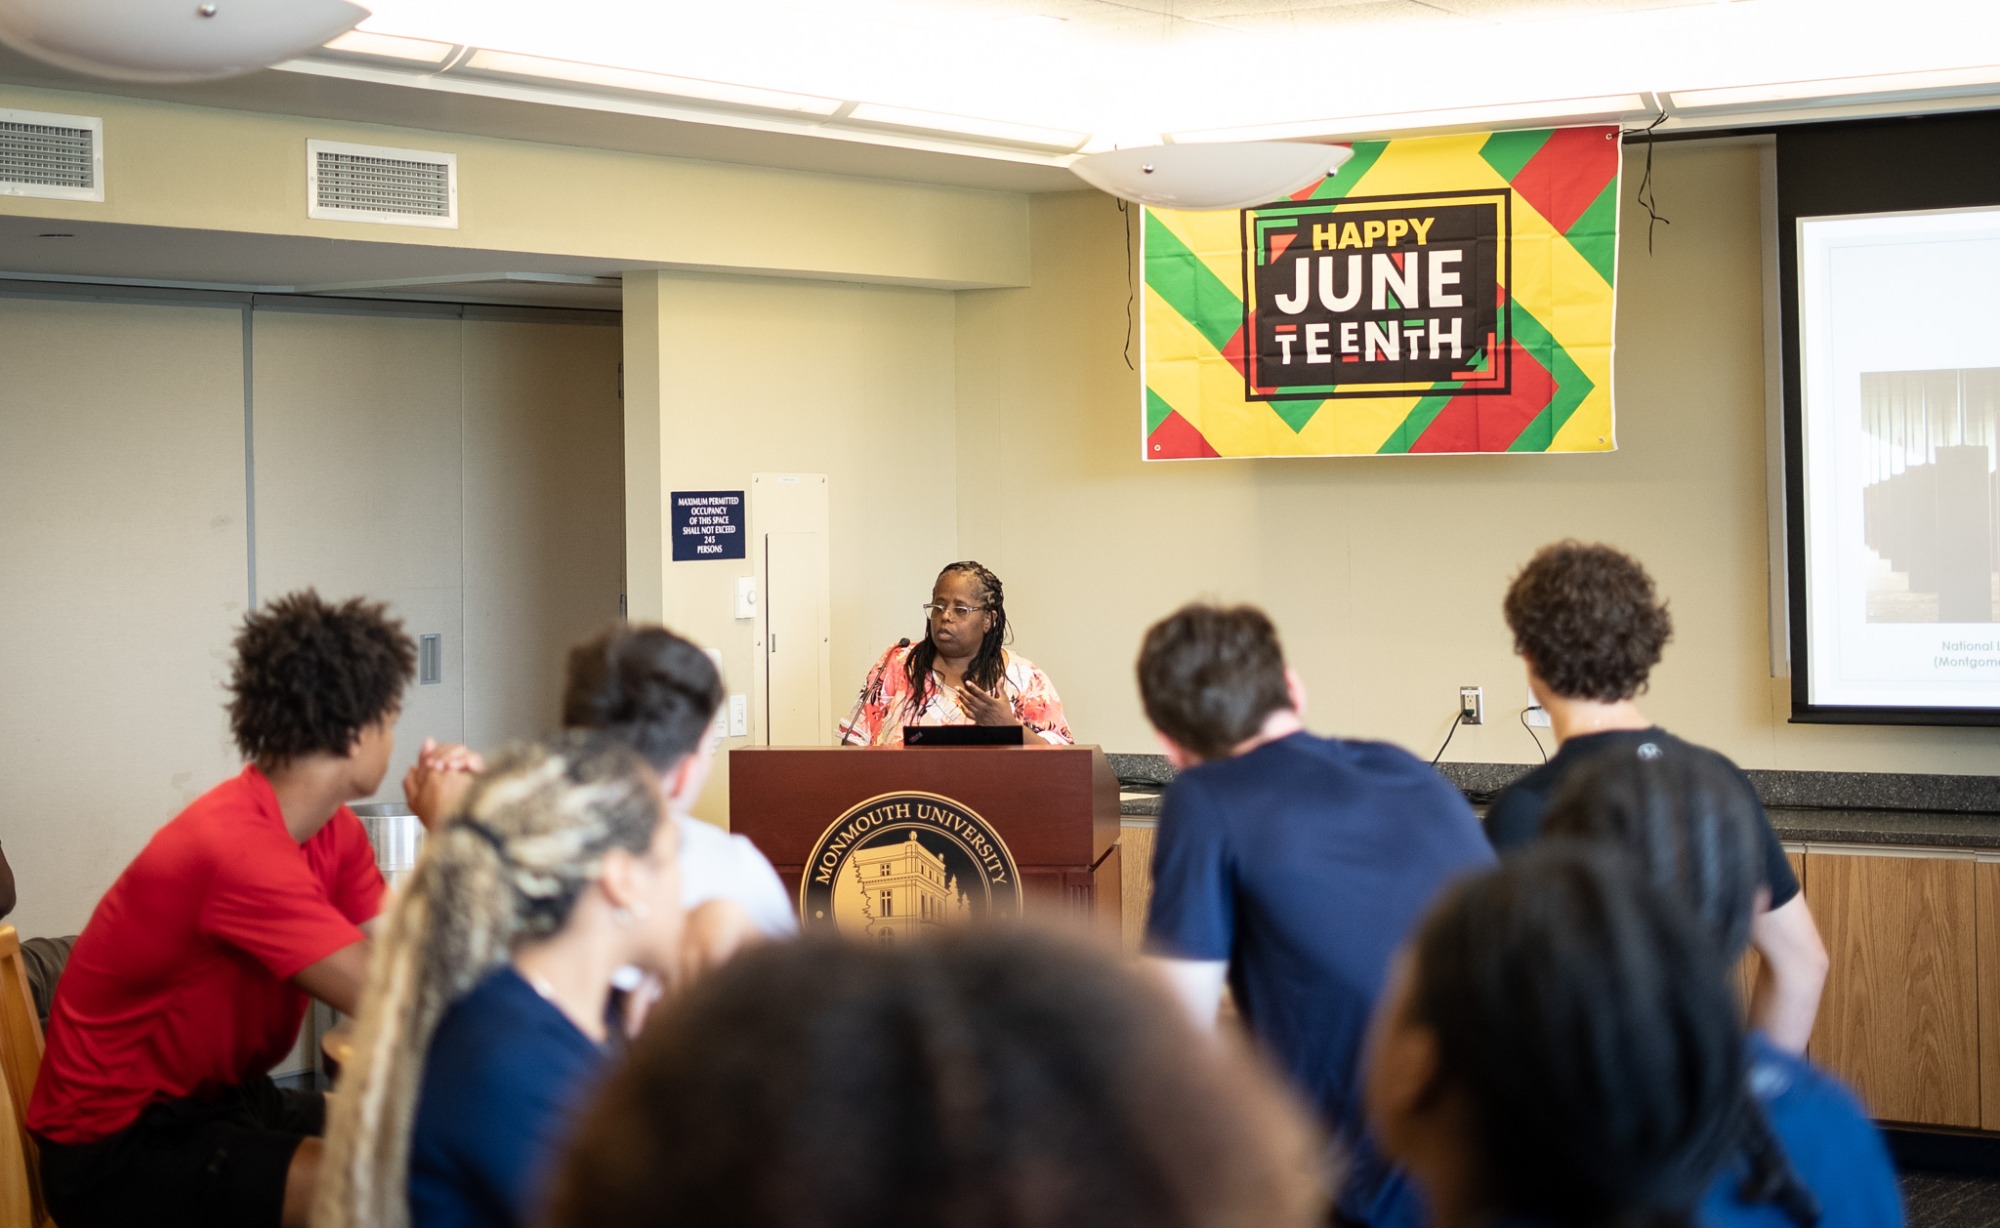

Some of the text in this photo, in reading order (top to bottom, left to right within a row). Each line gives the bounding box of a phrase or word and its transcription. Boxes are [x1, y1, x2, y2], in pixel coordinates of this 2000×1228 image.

[1312, 217, 1435, 251] HAPPY
[1274, 249, 1464, 315] JUNE
[1275, 317, 1463, 366] TEENTH
[678, 496, 739, 506] MAXIMUM PERMITTED
[691, 506, 727, 515] OCCUPANCY
[689, 516, 729, 525] OF THIS SPACE
[682, 525, 736, 535] SHALL NOT EXCEED
[704, 535, 715, 544] 245
[697, 545, 723, 554] PERSONS
[1942, 640, 1993, 651] National
[815, 803, 1008, 886] MONMOUTH UNIVERSITY
